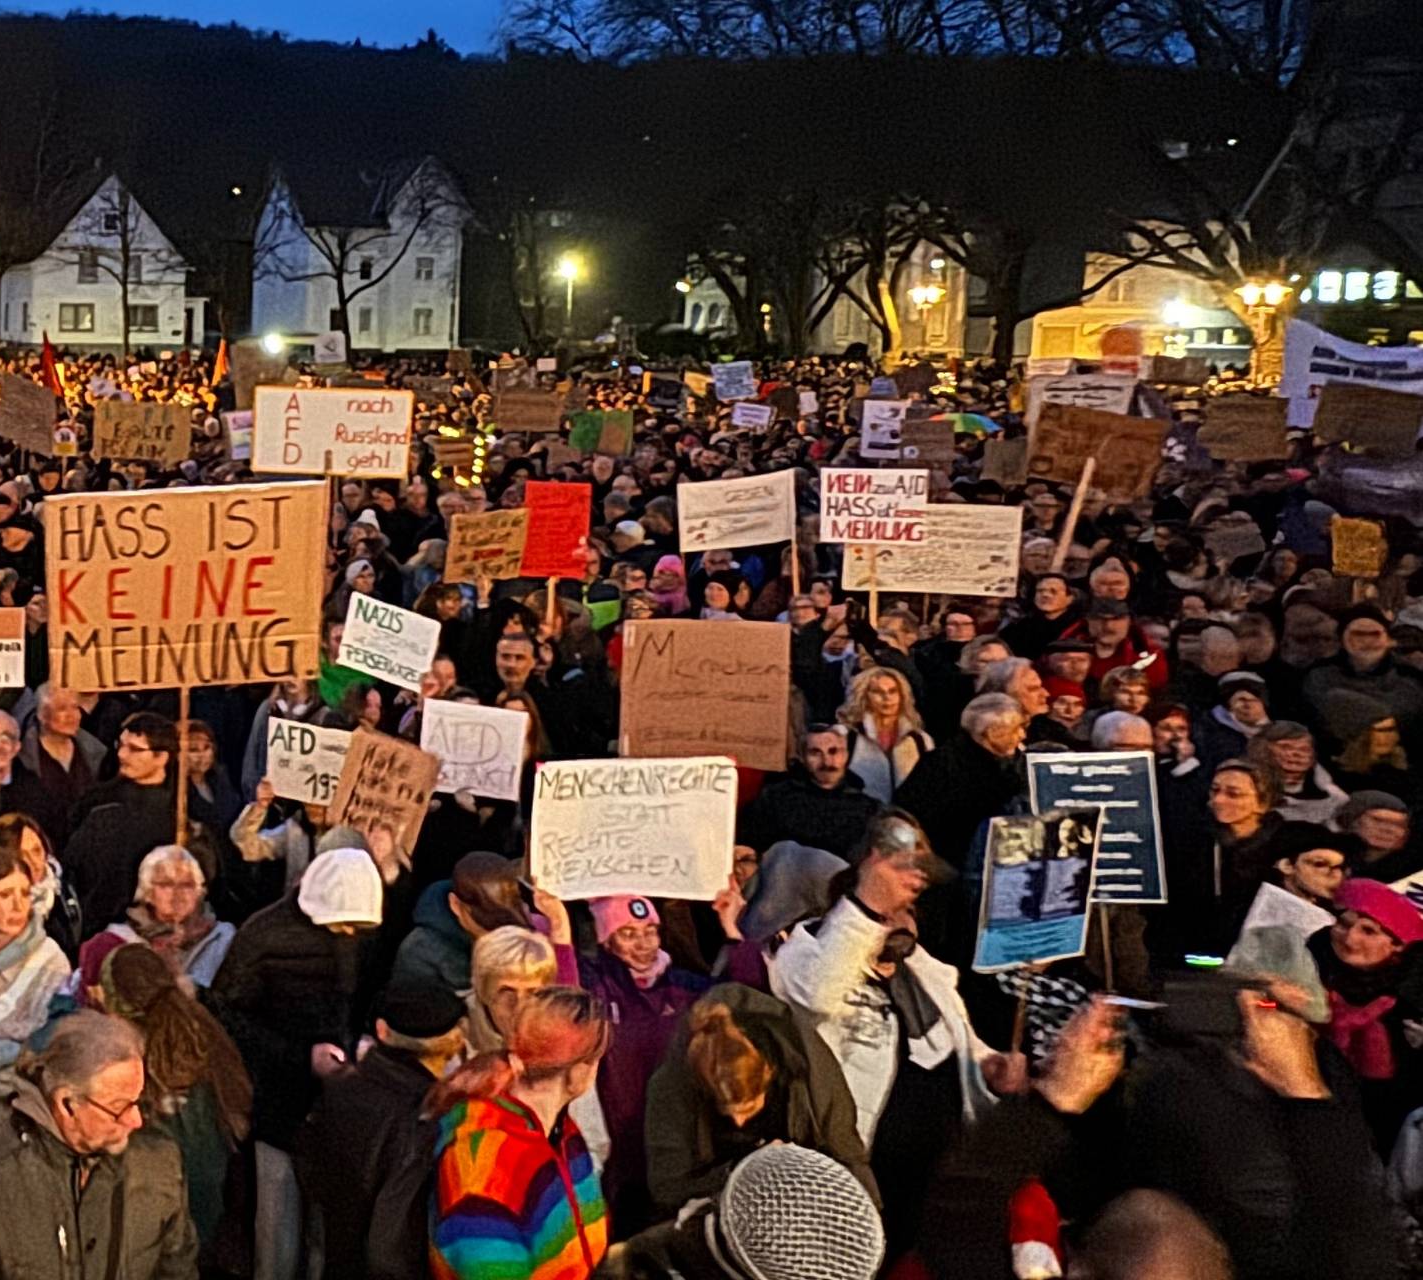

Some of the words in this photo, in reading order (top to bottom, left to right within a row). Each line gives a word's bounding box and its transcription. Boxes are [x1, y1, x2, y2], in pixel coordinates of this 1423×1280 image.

[347, 395, 394, 413] nach
[335, 422, 410, 445] Russland
[827, 474, 873, 495] NEIN
[895, 475, 927, 499] AfD
[827, 497, 876, 518] HASS
[59, 502, 171, 562] HASS
[207, 495, 292, 552] IST
[831, 519, 924, 542] MEINUNG
[58, 556, 277, 625] KEINE
[355, 597, 404, 635] NAZIS
[269, 722, 316, 756] AFD
[427, 715, 503, 766] AFD
[539, 762, 733, 801] MENSCHENRECHTE
